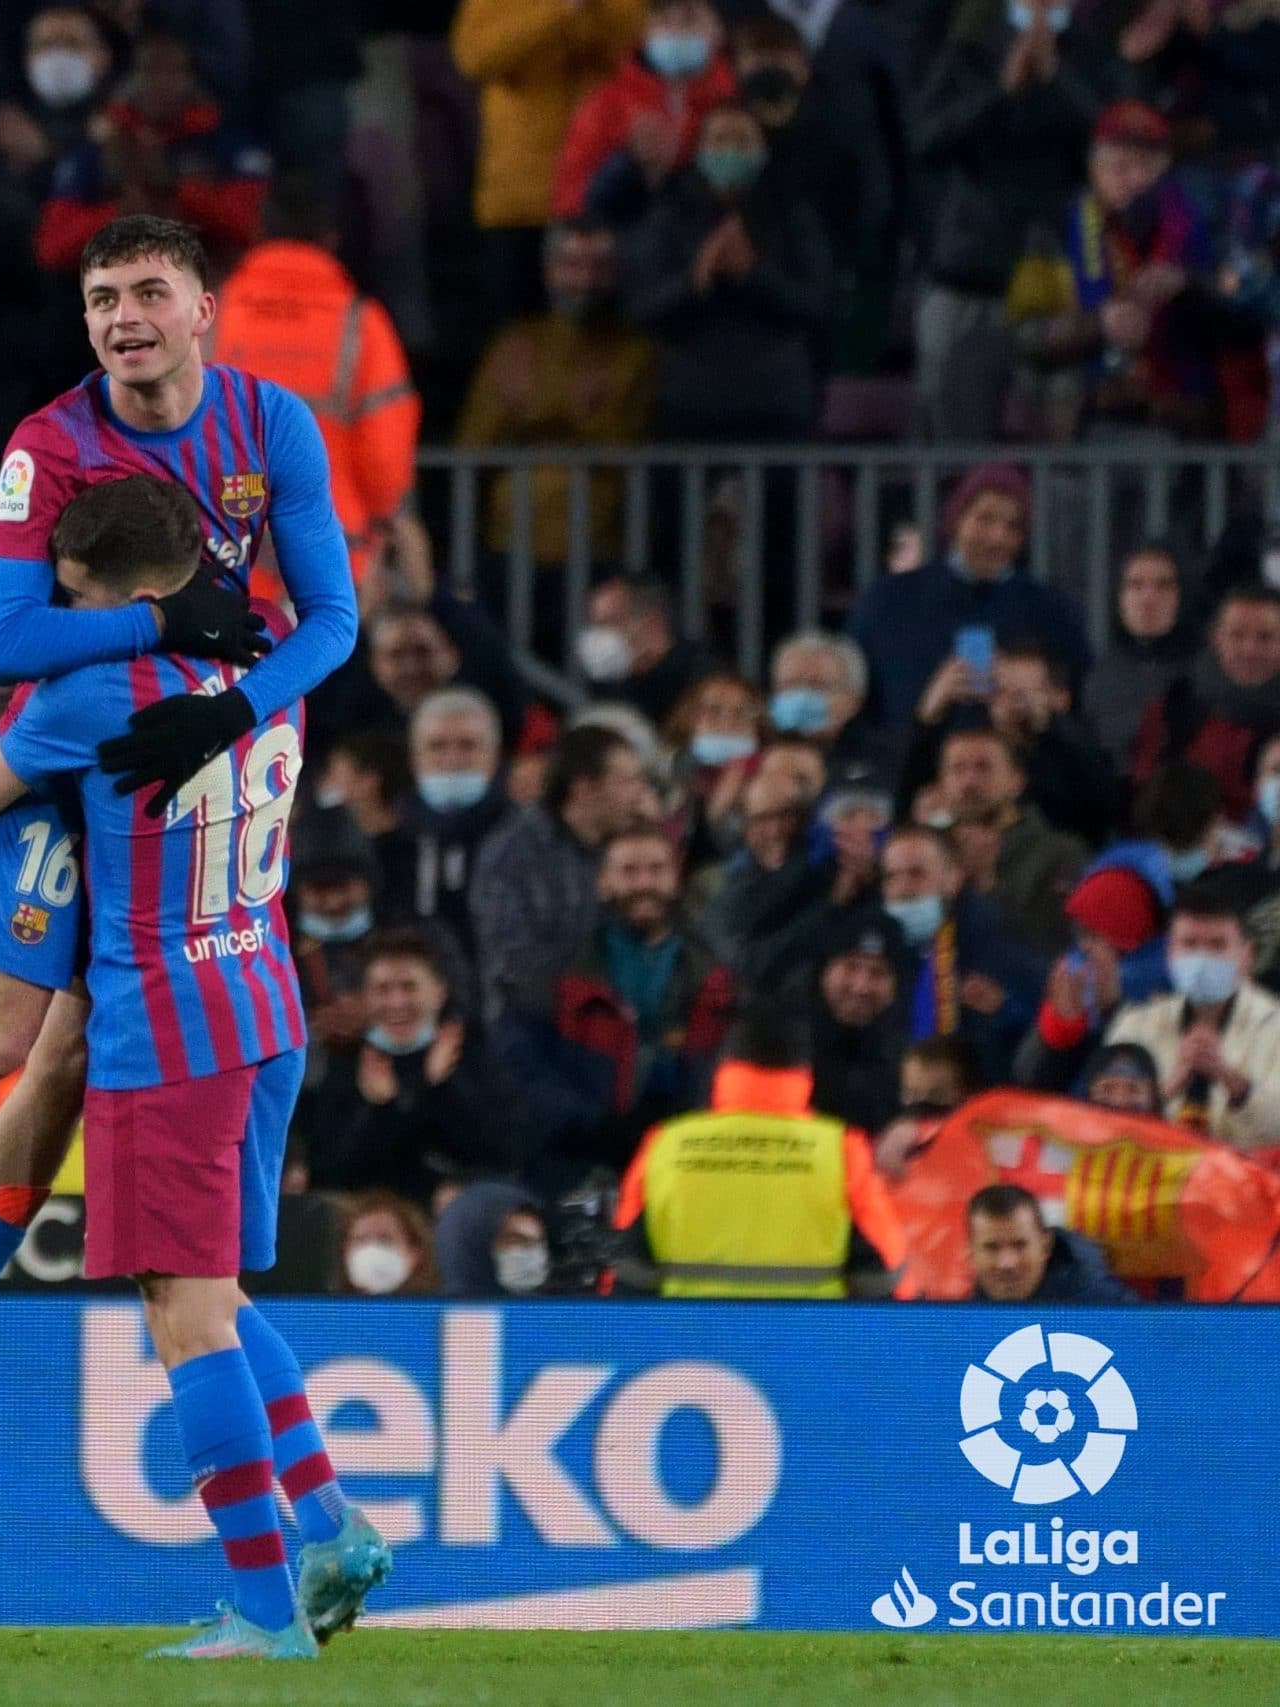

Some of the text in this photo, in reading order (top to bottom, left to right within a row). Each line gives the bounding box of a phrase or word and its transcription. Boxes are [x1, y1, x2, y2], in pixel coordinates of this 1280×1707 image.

[16, 820, 80, 908] 16
[166, 722, 303, 925] 18
[183, 918, 265, 964] unicef
[78, 1306, 784, 1552] beko
